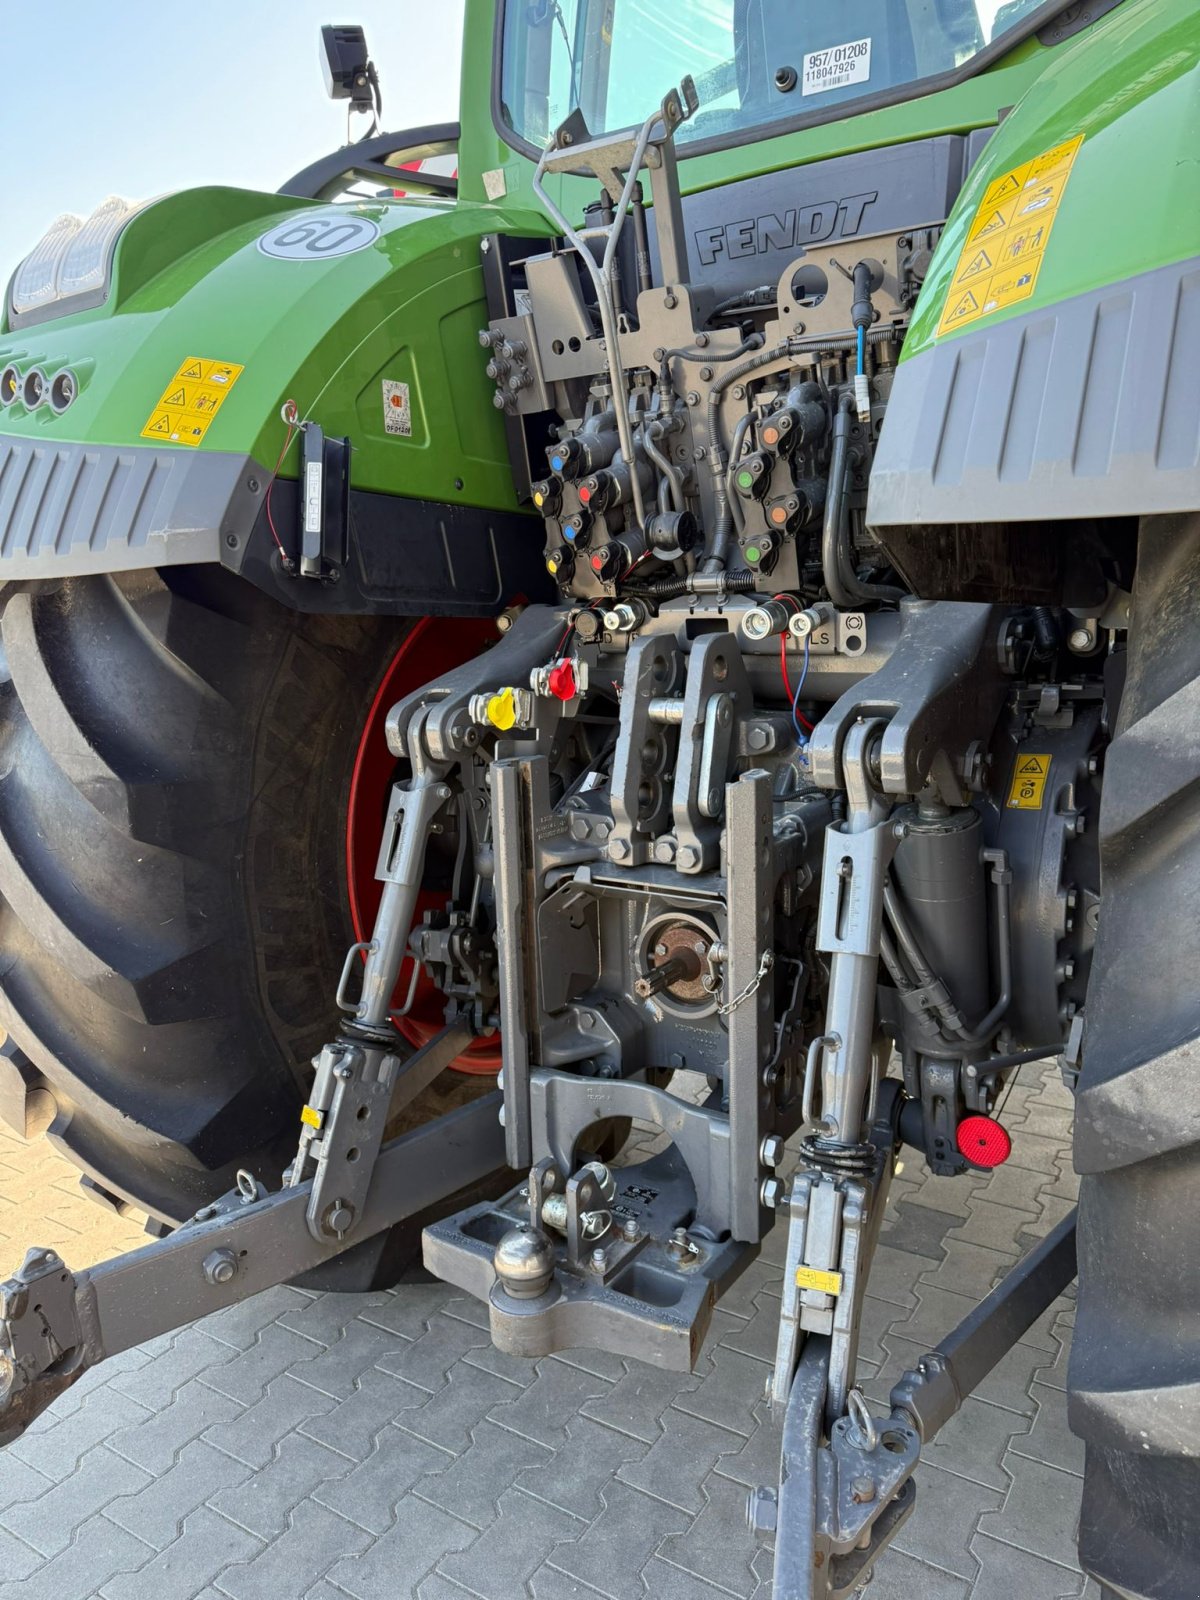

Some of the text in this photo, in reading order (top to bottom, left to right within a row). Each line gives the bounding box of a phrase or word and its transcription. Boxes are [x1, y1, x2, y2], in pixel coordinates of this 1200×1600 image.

[805, 60, 856, 82] 118047926
[273, 220, 363, 252] 60
[694, 191, 879, 265] FENDT
[810, 632, 830, 645] LS
